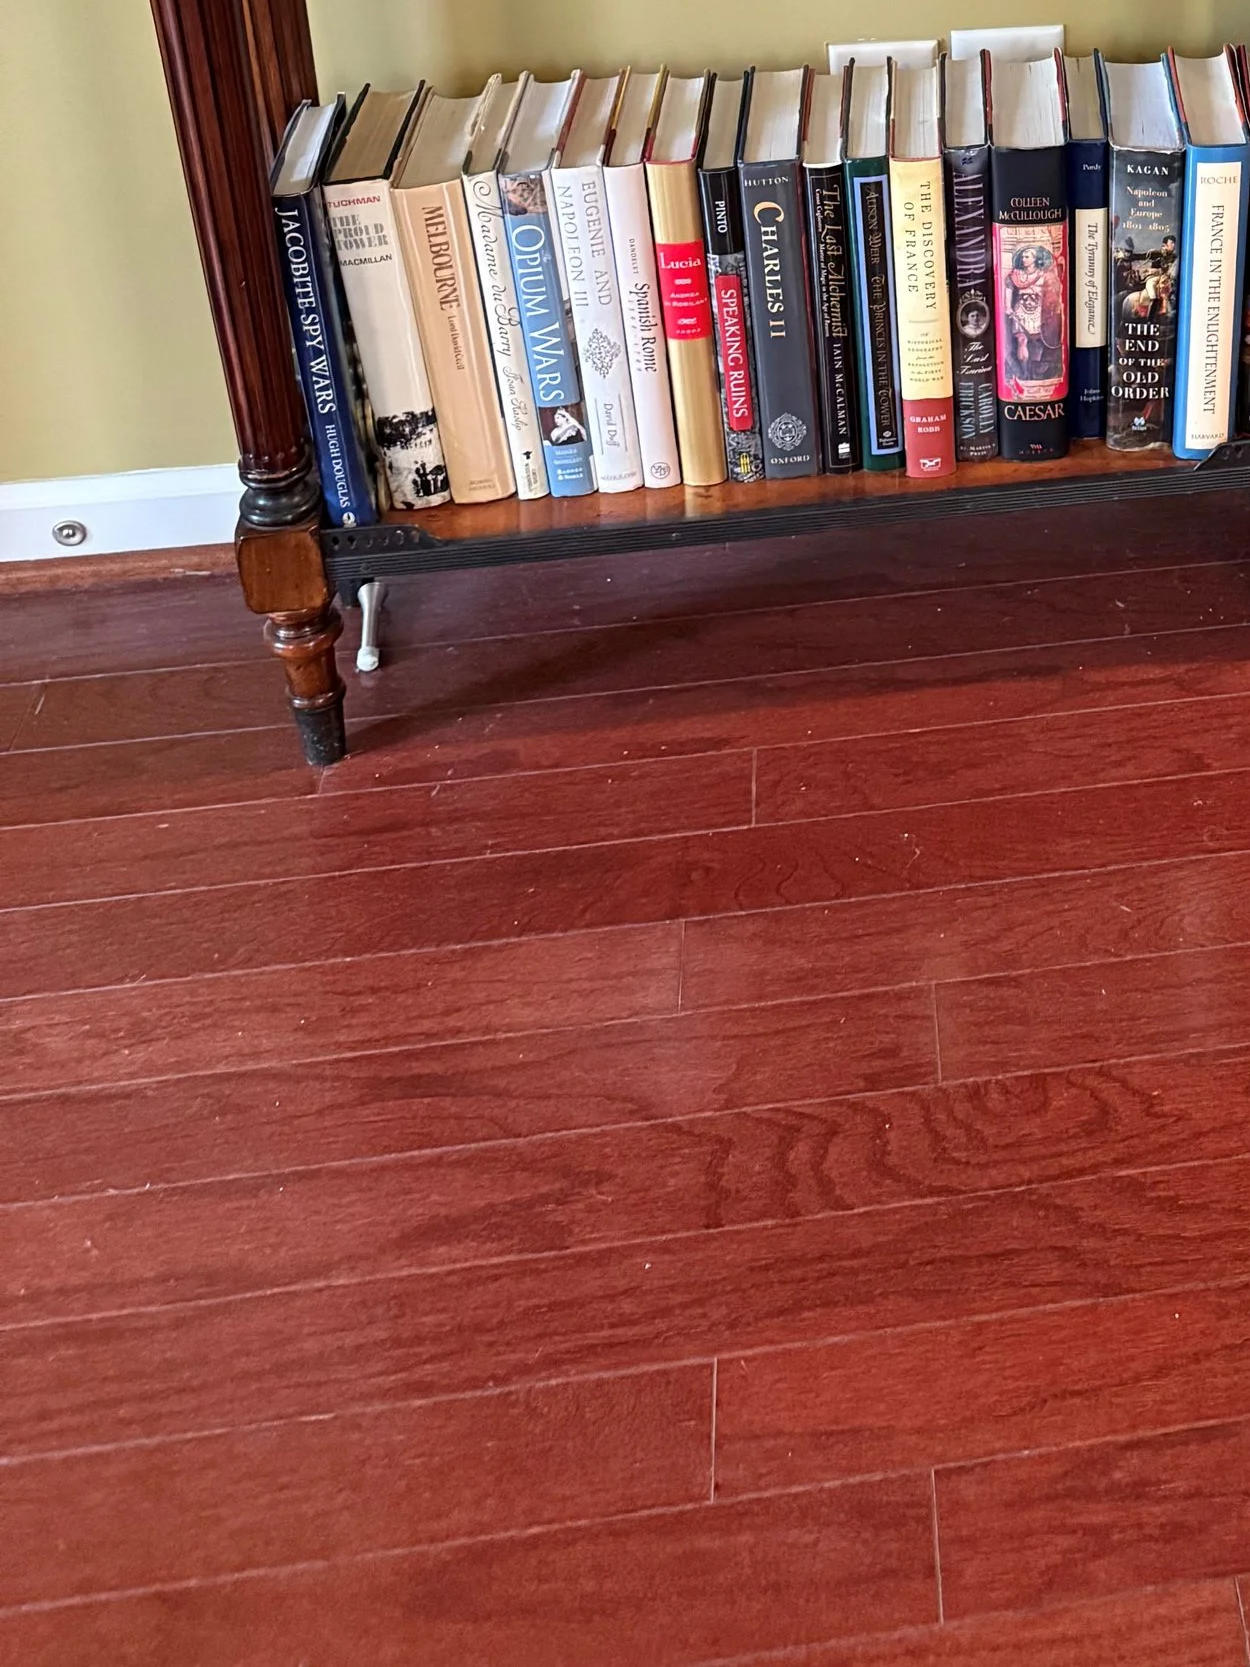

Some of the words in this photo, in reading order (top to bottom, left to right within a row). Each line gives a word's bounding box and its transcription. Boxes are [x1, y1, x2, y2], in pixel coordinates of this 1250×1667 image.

[744, 176, 789, 187] HUTTON
[1126, 164, 1169, 176] KAGAN
[1200, 175, 1238, 185] ROCHE
[328, 195, 381, 208] TUCHMAN
[822, 184, 840, 218] The
[920, 181, 932, 213] THE
[1010, 197, 1050, 208] COLLEEN
[1126, 186, 1168, 198] Napoleon
[1138, 199, 1155, 207] and
[715, 200, 728, 233] PINTO
[866, 187, 878, 230] ALISON
[904, 201, 915, 221] OF
[999, 209, 1062, 221] McCULLOUGH
[1130, 208, 1163, 219] Europe
[336, 234, 389, 251] TOWER
[582, 181, 606, 258] EUGENIE
[594, 270, 613, 306] AND
[821, 225, 842, 255] Last
[953, 172, 986, 288] ALEXANDRA
[1086, 222, 1098, 239] The
[1209, 205, 1225, 255] FRANCE
[275, 207, 316, 309] JACOBITE
[340, 254, 393, 267] MACMILLAN
[422, 206, 461, 311] MELBOURNE
[557, 186, 586, 282] NAPOLEON
[574, 291, 589, 307] III
[659, 252, 702, 269] Lucia
[868, 233, 882, 265] WEIR
[905, 229, 919, 293] FRANCE
[1083, 241, 1098, 277] Tyranny
[473, 181, 503, 281] Madame
[495, 303, 521, 357] Barry
[511, 224, 549, 318] OPIUM
[753, 201, 785, 313] CHARLES
[769, 319, 785, 338] II
[922, 222, 937, 310] DISCOVERY
[1209, 258, 1222, 274] IN
[827, 262, 848, 338] Alchemist
[1084, 280, 1098, 289] of
[1208, 274, 1222, 302] THE
[629, 283, 658, 332] Spanish
[1083, 290, 1098, 334] Elegance
[300, 313, 325, 348] SPY
[721, 289, 743, 366] SPEAKING
[870, 301, 887, 351] PRINCES
[1125, 323, 1160, 336] THE
[528, 321, 565, 402] WARS
[642, 336, 657, 373] Rome
[832, 343, 843, 369] IAIN
[877, 351, 887, 363] IN
[1125, 339, 1160, 352] END
[1203, 304, 1221, 414] ENLIGHTENMENT
[877, 363, 888, 387] THE
[1118, 357, 1136, 366] OF
[1139, 358, 1165, 367] THE
[1123, 371, 1159, 384] OLD
[310, 356, 336, 414] WARS
[729, 370, 749, 418] RUINS
[1111, 386, 1170, 399] ORDER
[835, 373, 848, 435] McCALMAN
[878, 387, 892, 427] TOWER
[910, 414, 946, 423] GRAHAM
[978, 383, 994, 434] CAROLLY
[1004, 403, 1065, 421] CAESAR
[325, 424, 341, 457] HUGH
[1191, 432, 1225, 440] HARVARD
[770, 454, 810, 465] OXFORD
[332, 458, 351, 509] DOUGLAS
